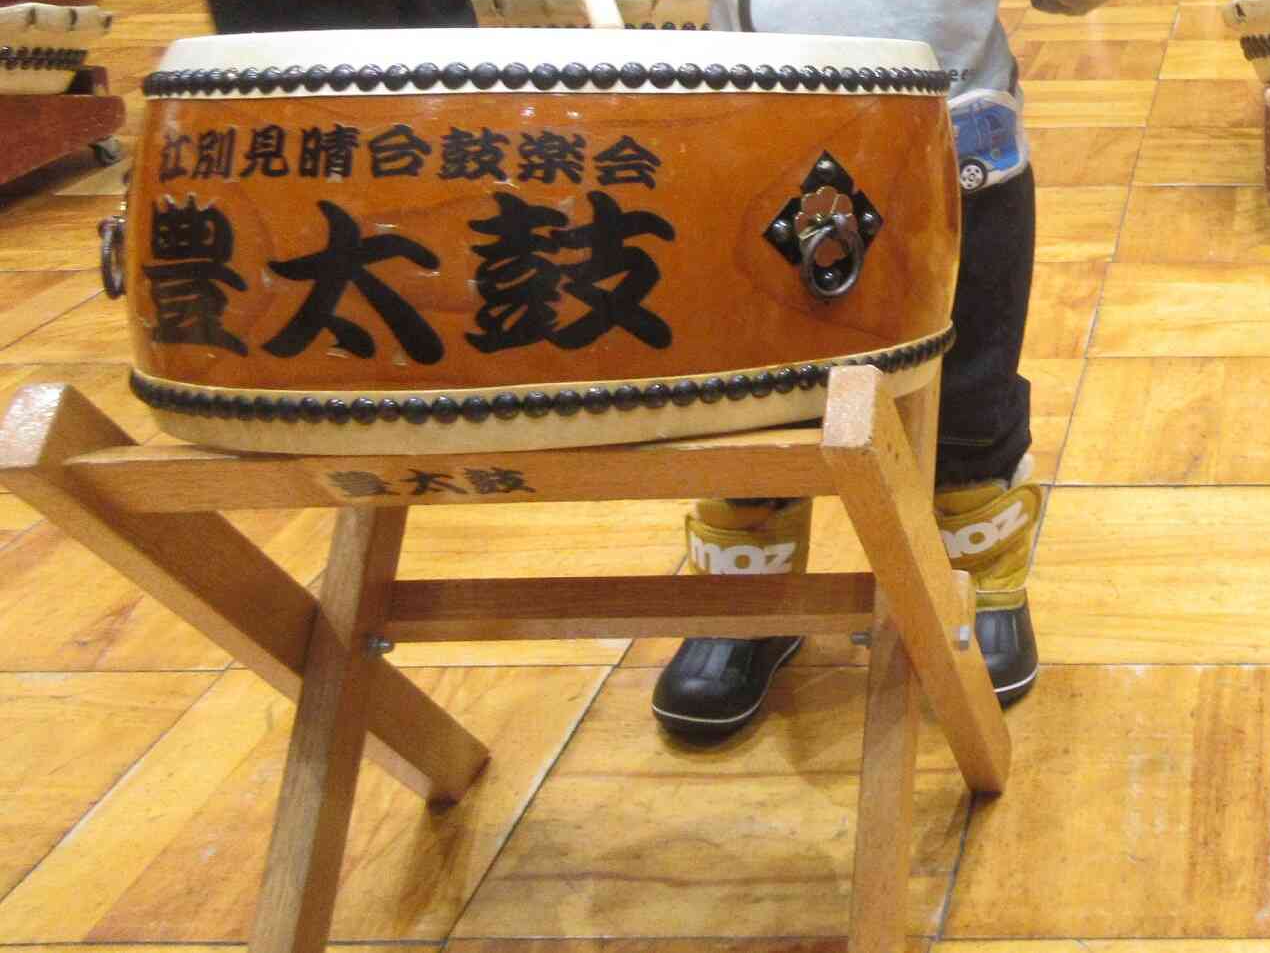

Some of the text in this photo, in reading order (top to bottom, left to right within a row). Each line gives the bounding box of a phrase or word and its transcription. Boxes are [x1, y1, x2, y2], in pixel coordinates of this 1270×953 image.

[158, 123, 662, 189] 江別見晴台鼓楽会
[143, 190, 677, 365] 豊太鼓
